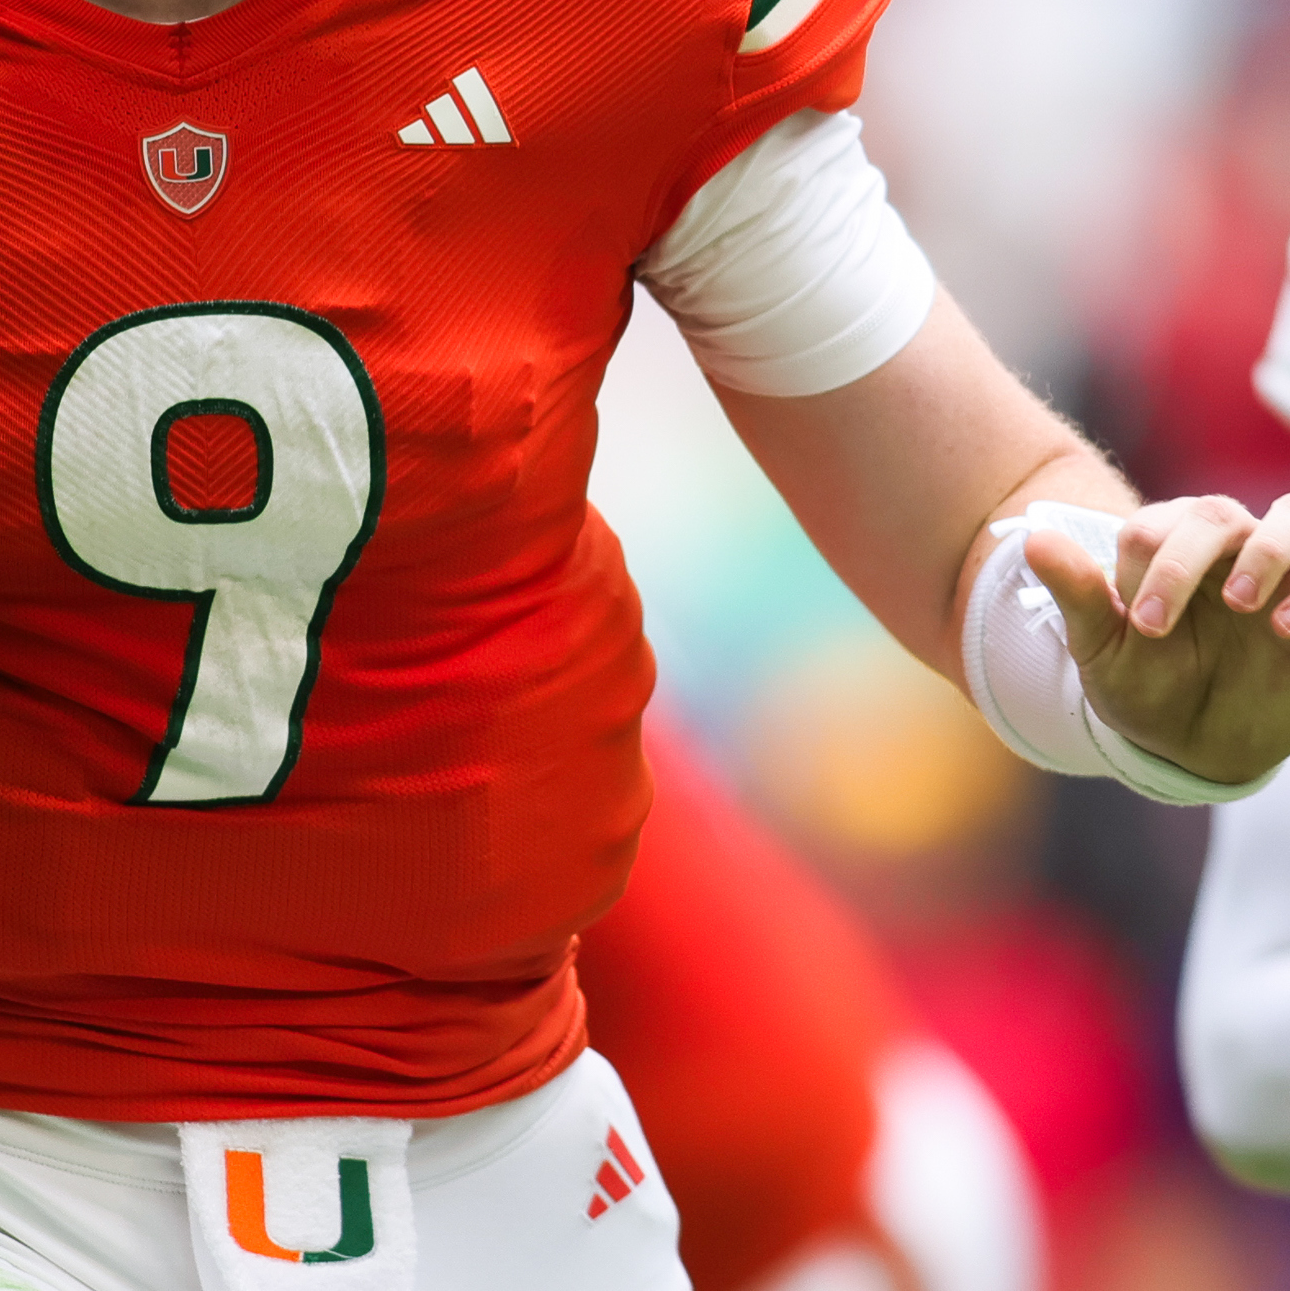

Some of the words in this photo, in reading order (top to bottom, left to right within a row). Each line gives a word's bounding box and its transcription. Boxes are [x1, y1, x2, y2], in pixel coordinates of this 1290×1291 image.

[158, 147, 213, 183] U
[35, 298, 388, 807] 9
[225, 1149, 375, 1264] U
